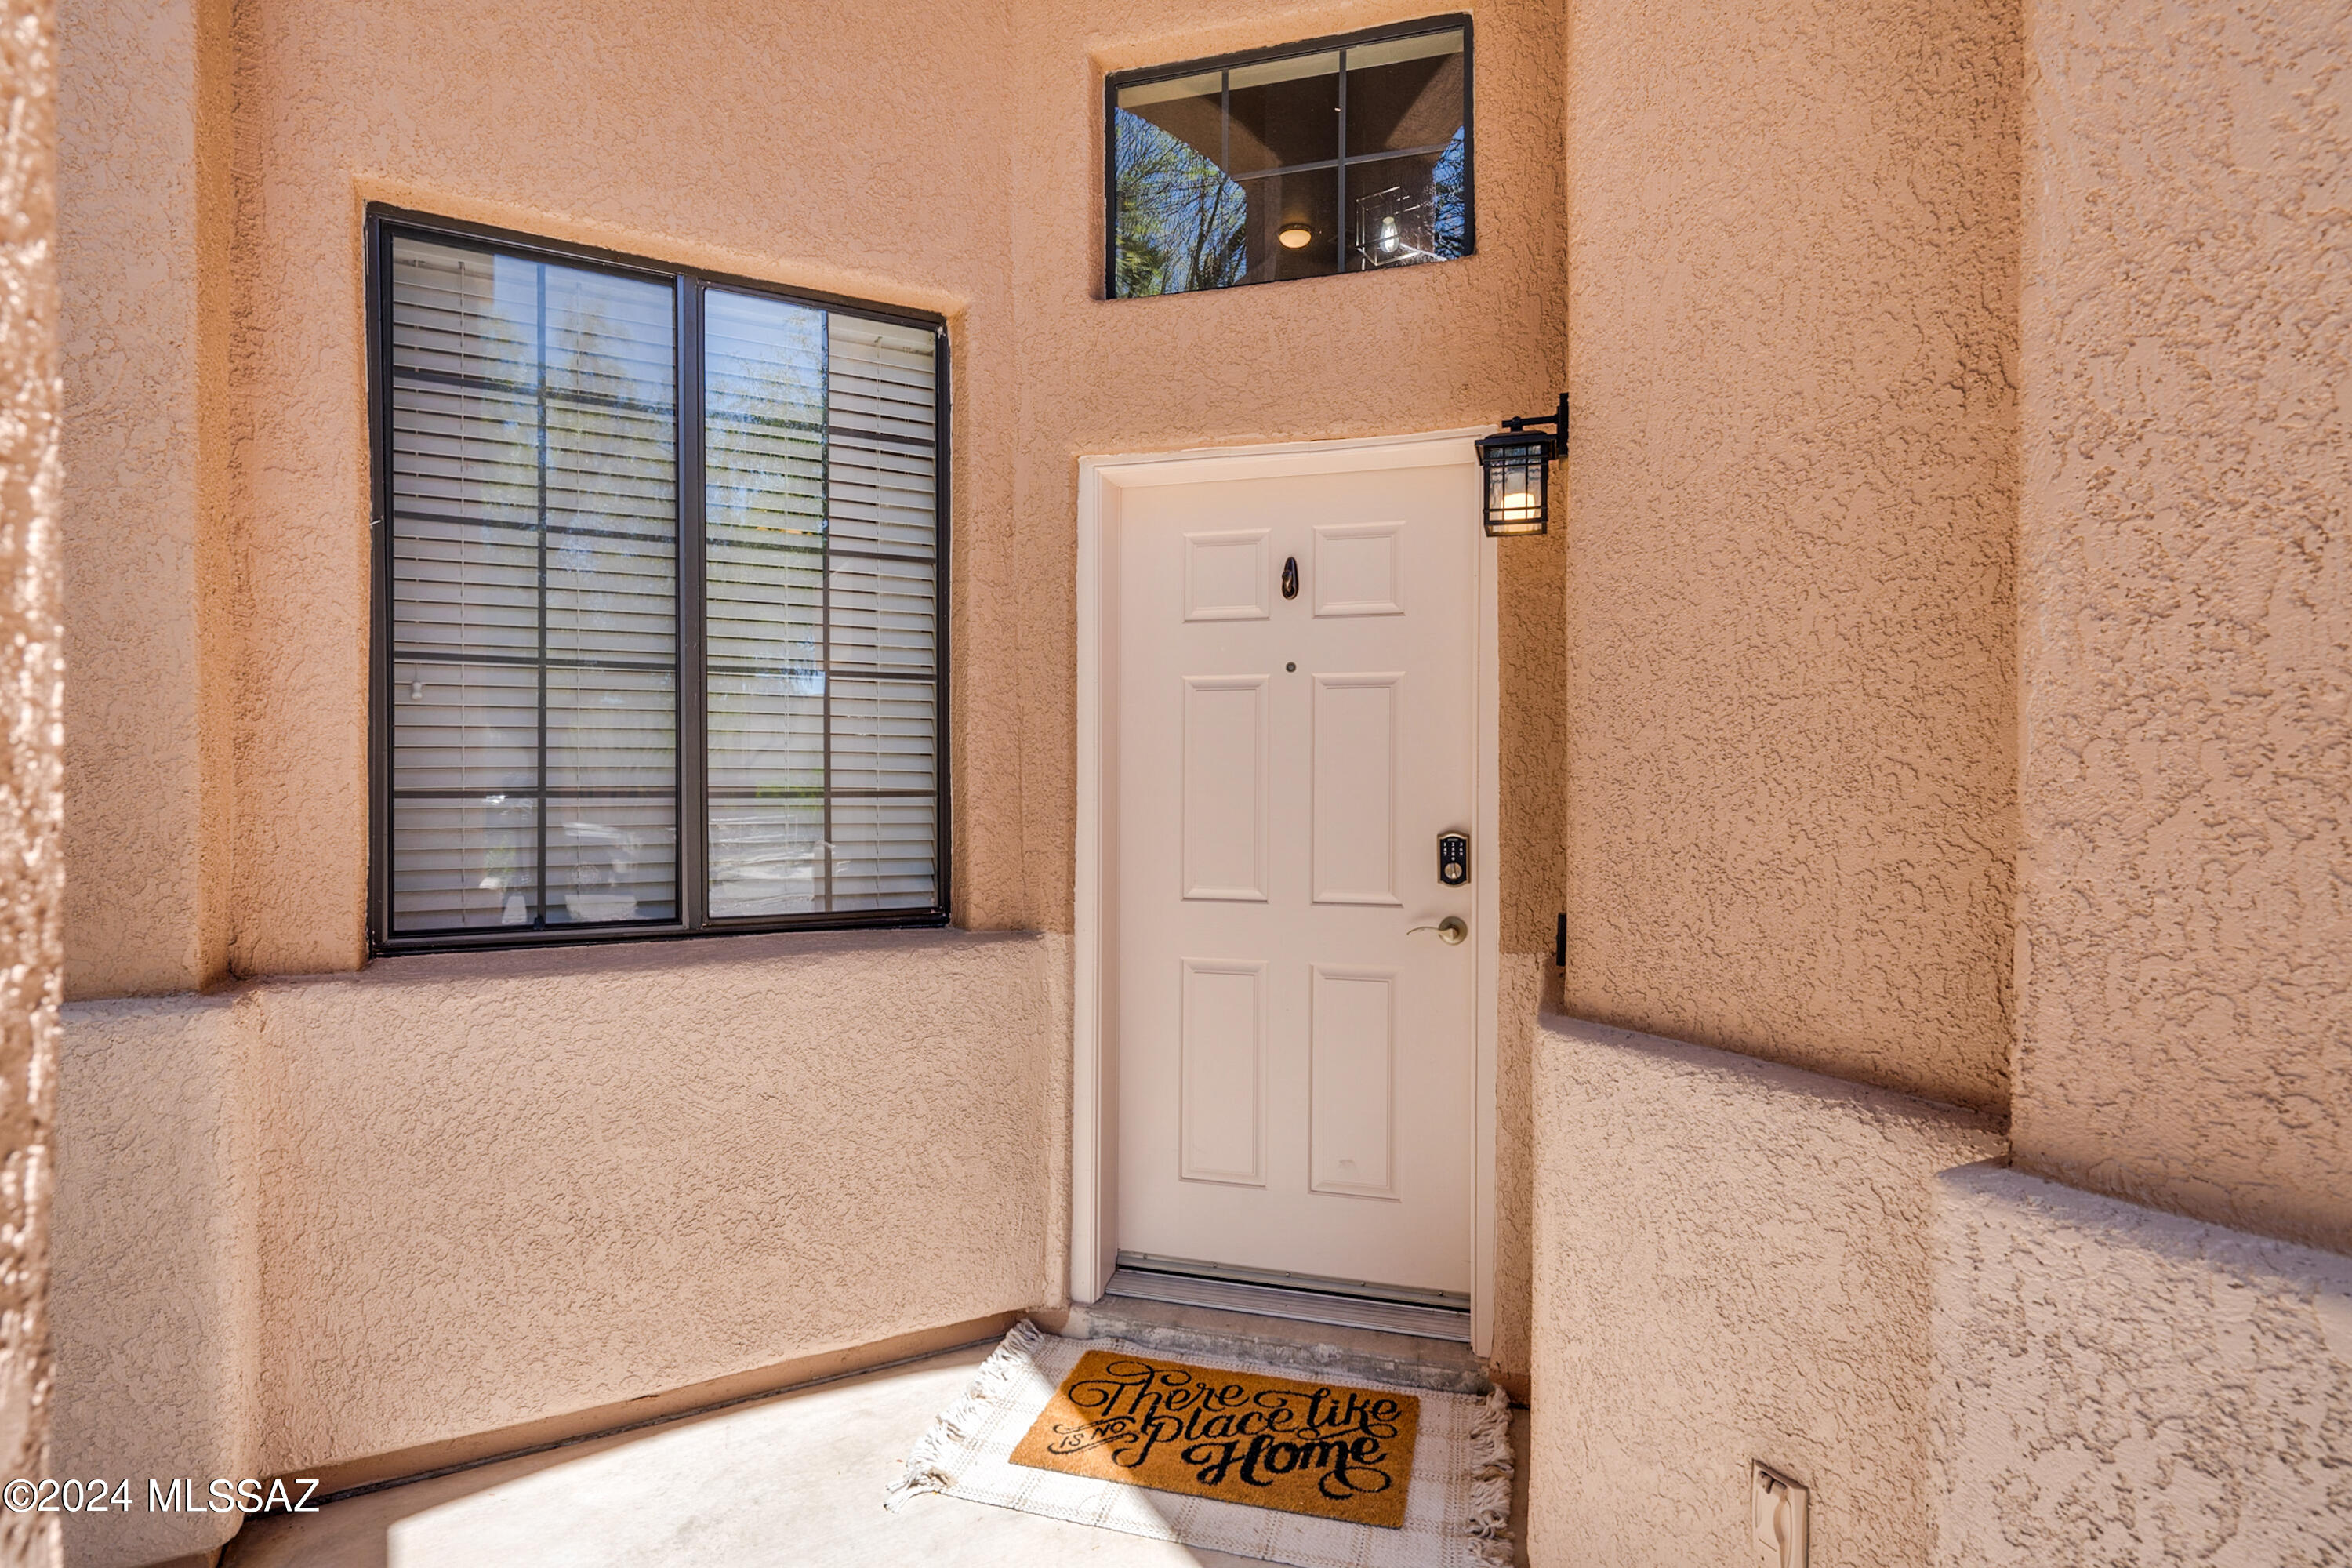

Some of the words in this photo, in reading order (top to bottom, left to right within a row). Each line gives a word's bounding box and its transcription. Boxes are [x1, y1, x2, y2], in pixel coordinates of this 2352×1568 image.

[1068, 1360, 1250, 1417] There
[1060, 1433, 1085, 1449] IS
[1091, 1421, 1127, 1440] NO
[1112, 1407, 1299, 1468] place
[1181, 1433, 1392, 1500] Home
